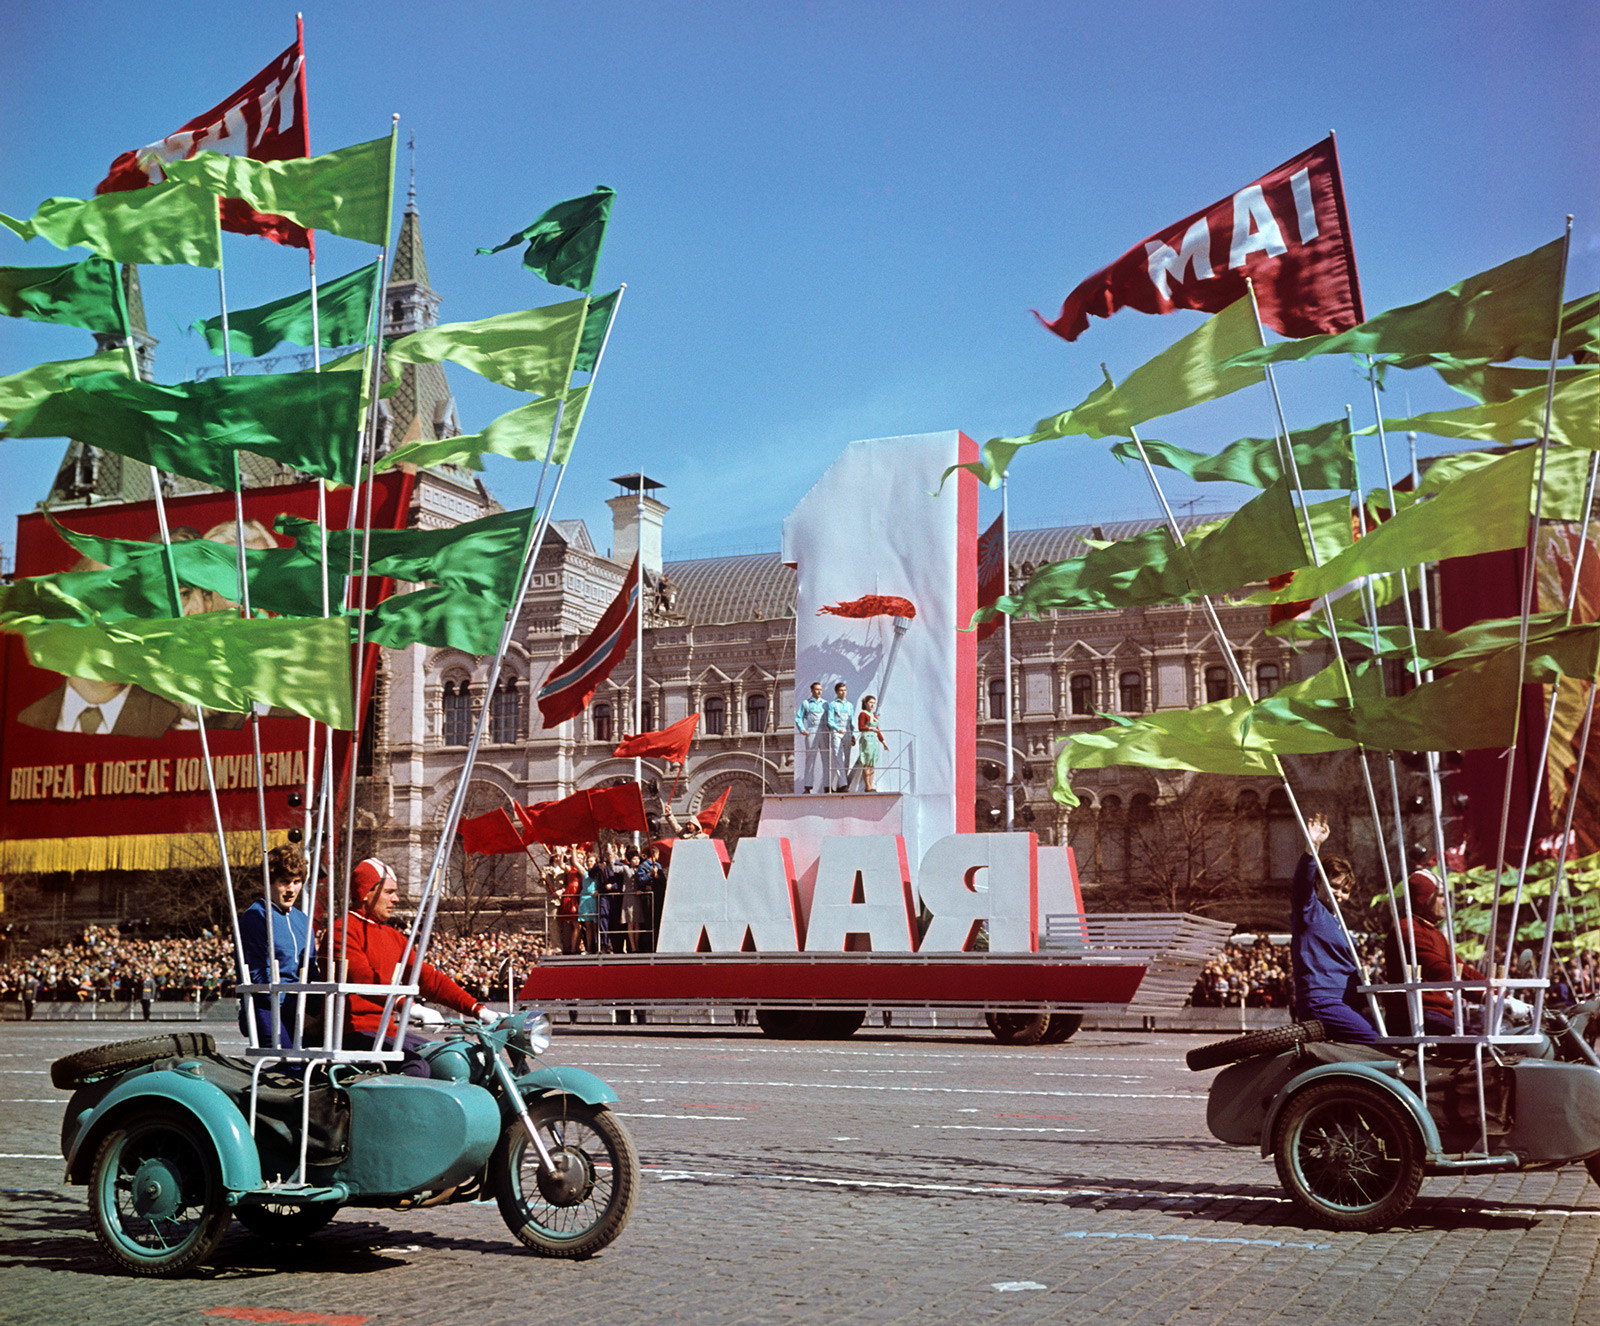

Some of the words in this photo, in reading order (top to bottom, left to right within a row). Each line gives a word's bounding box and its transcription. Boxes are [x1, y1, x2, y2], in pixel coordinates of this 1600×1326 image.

[782, 428, 979, 834] 1
[10, 764, 82, 800] ВПЕРЕД,
[84, 763, 97, 796] К
[101, 759, 170, 795] ПОБЕДЕ
[656, 832, 1038, 953] МАЯ
